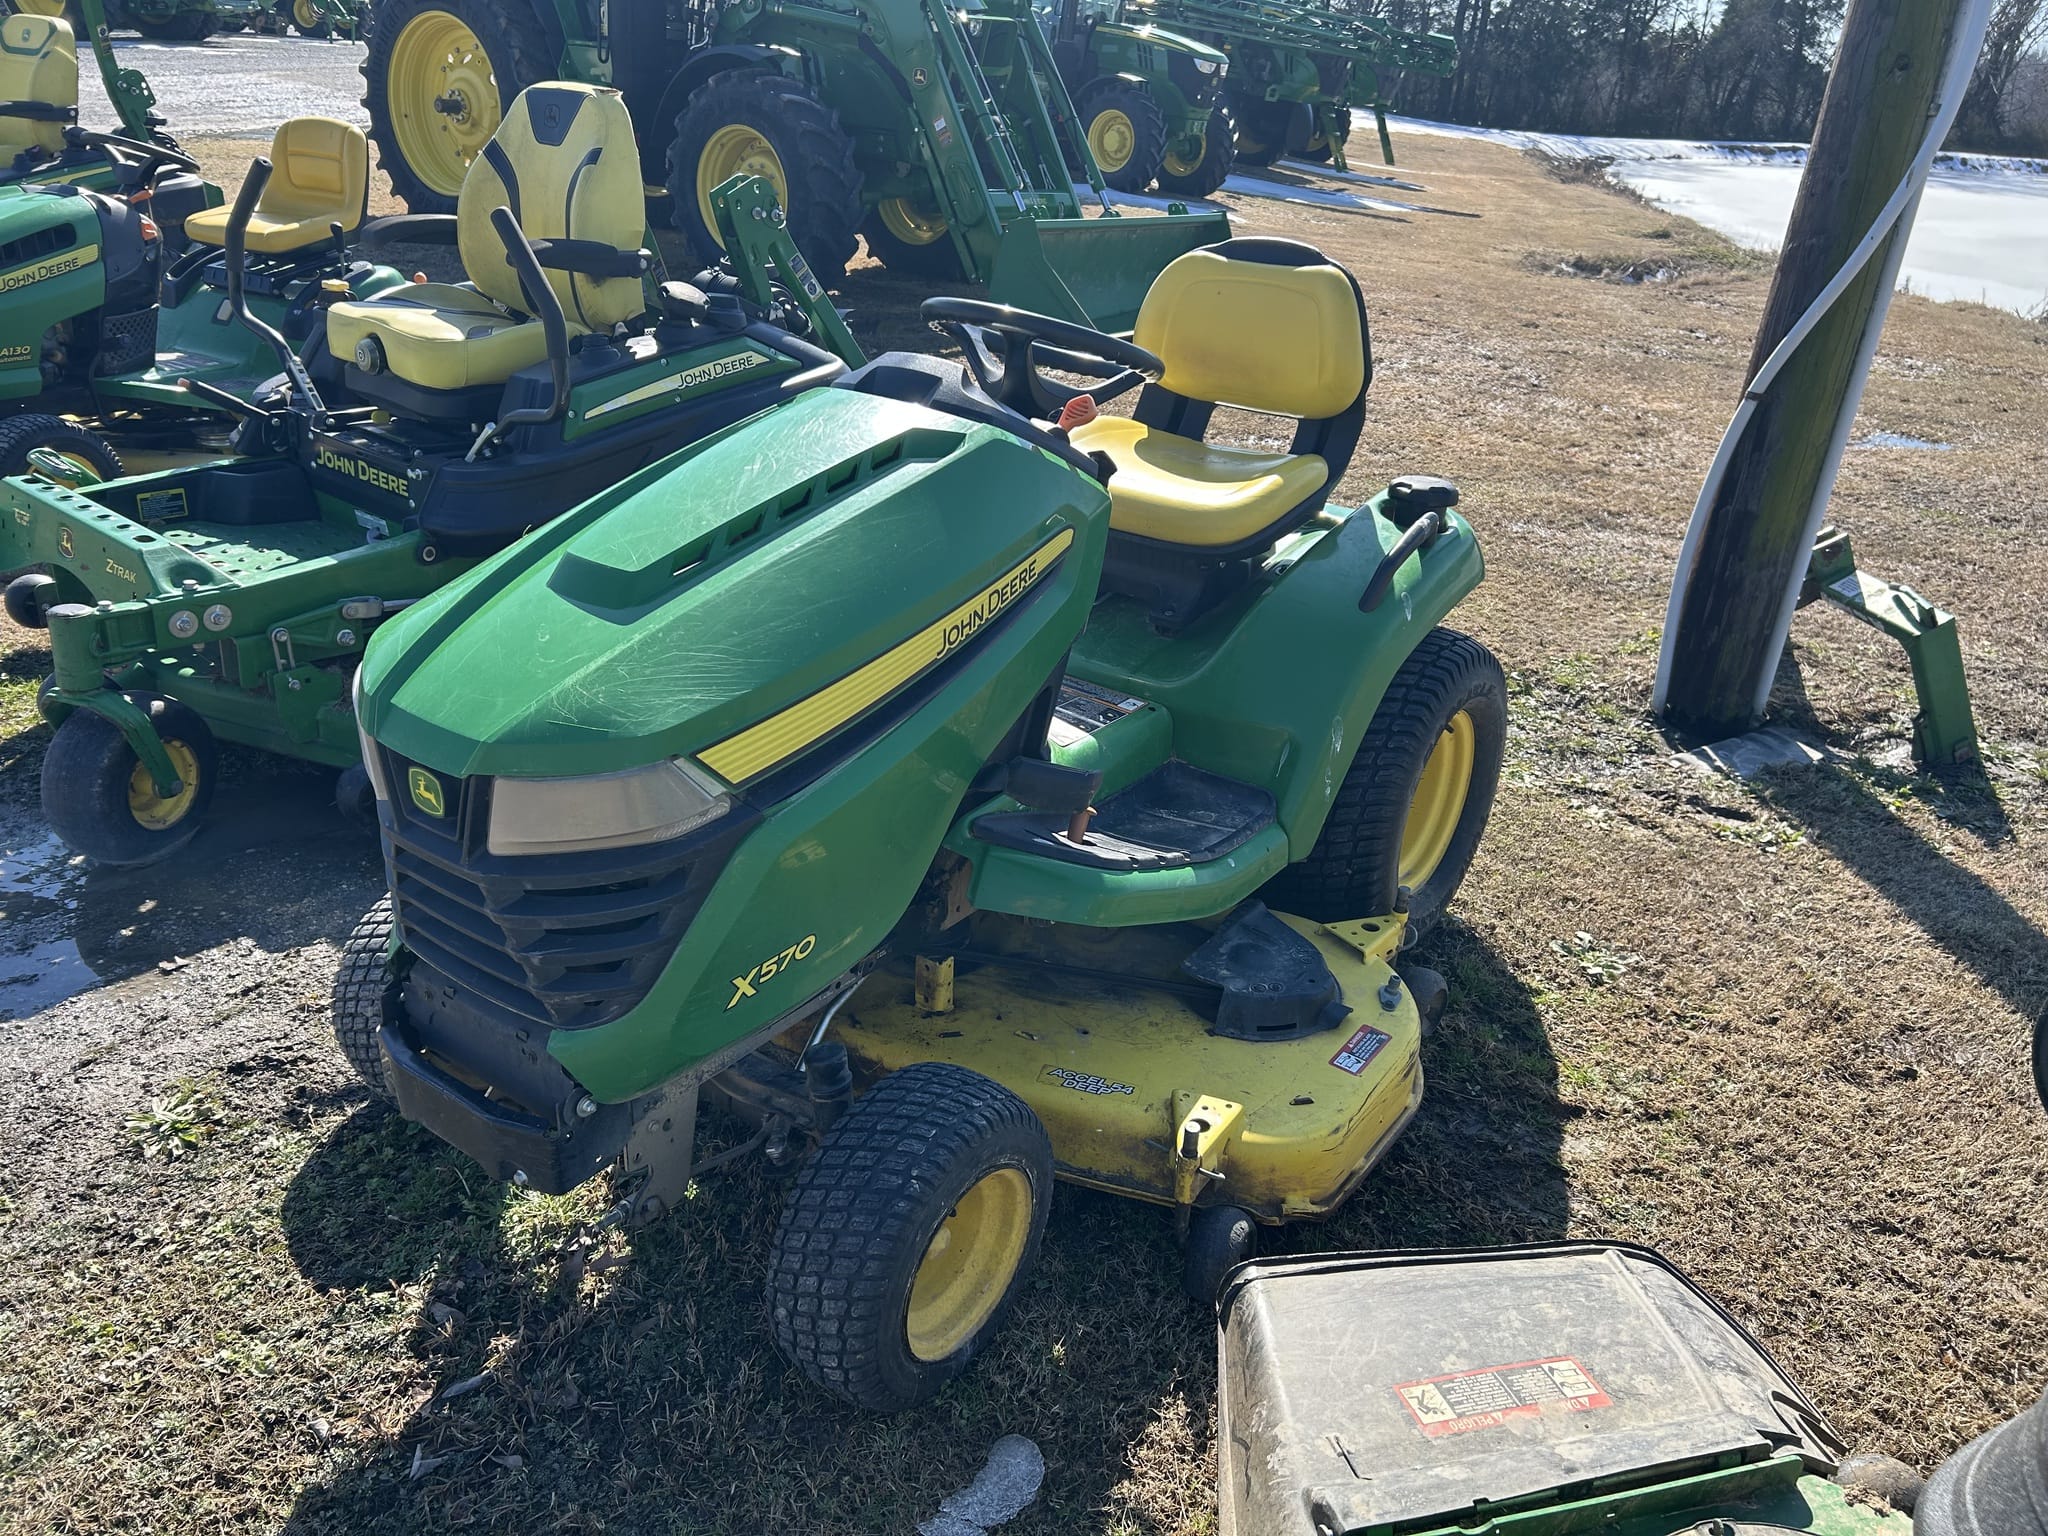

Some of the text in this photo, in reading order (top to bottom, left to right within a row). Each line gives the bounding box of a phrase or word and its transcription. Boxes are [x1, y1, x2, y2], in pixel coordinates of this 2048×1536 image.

[0, 257, 80, 291] JOHN DEERE
[0, 345, 31, 356] A130
[678, 355, 755, 388] JOHN DEERE
[317, 446, 409, 497] JOHN DEERE
[106, 558, 137, 584] ZTRAK
[936, 558, 1037, 657] JOHN DEERE
[725, 934, 817, 1011] X570
[1049, 1068, 1135, 1095] ACCEL 54
[1062, 1079, 1112, 1095] DEEP
[1449, 1416, 1494, 1431] PELIGRO
